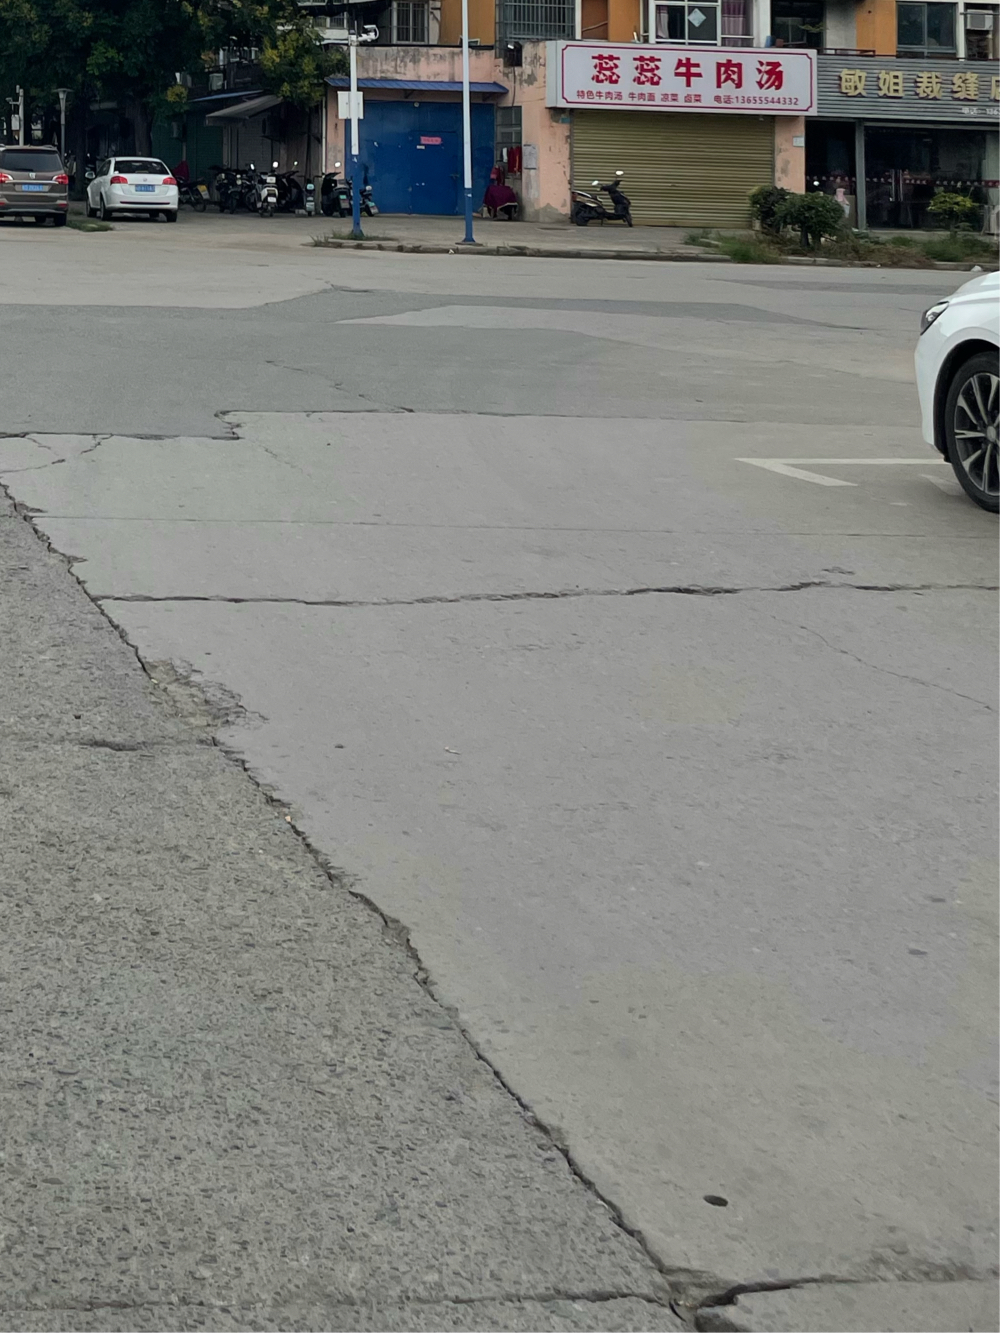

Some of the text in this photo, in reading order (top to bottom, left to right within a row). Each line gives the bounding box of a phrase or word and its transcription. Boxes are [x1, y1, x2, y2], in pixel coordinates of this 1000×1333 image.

[591, 54, 784, 91] 蕊蕊牛肉汤
[576, 90, 623, 101] 特色牛肉汤
[628, 92, 656, 102] 牛肉面
[986, 108, 1000, 116] 136
